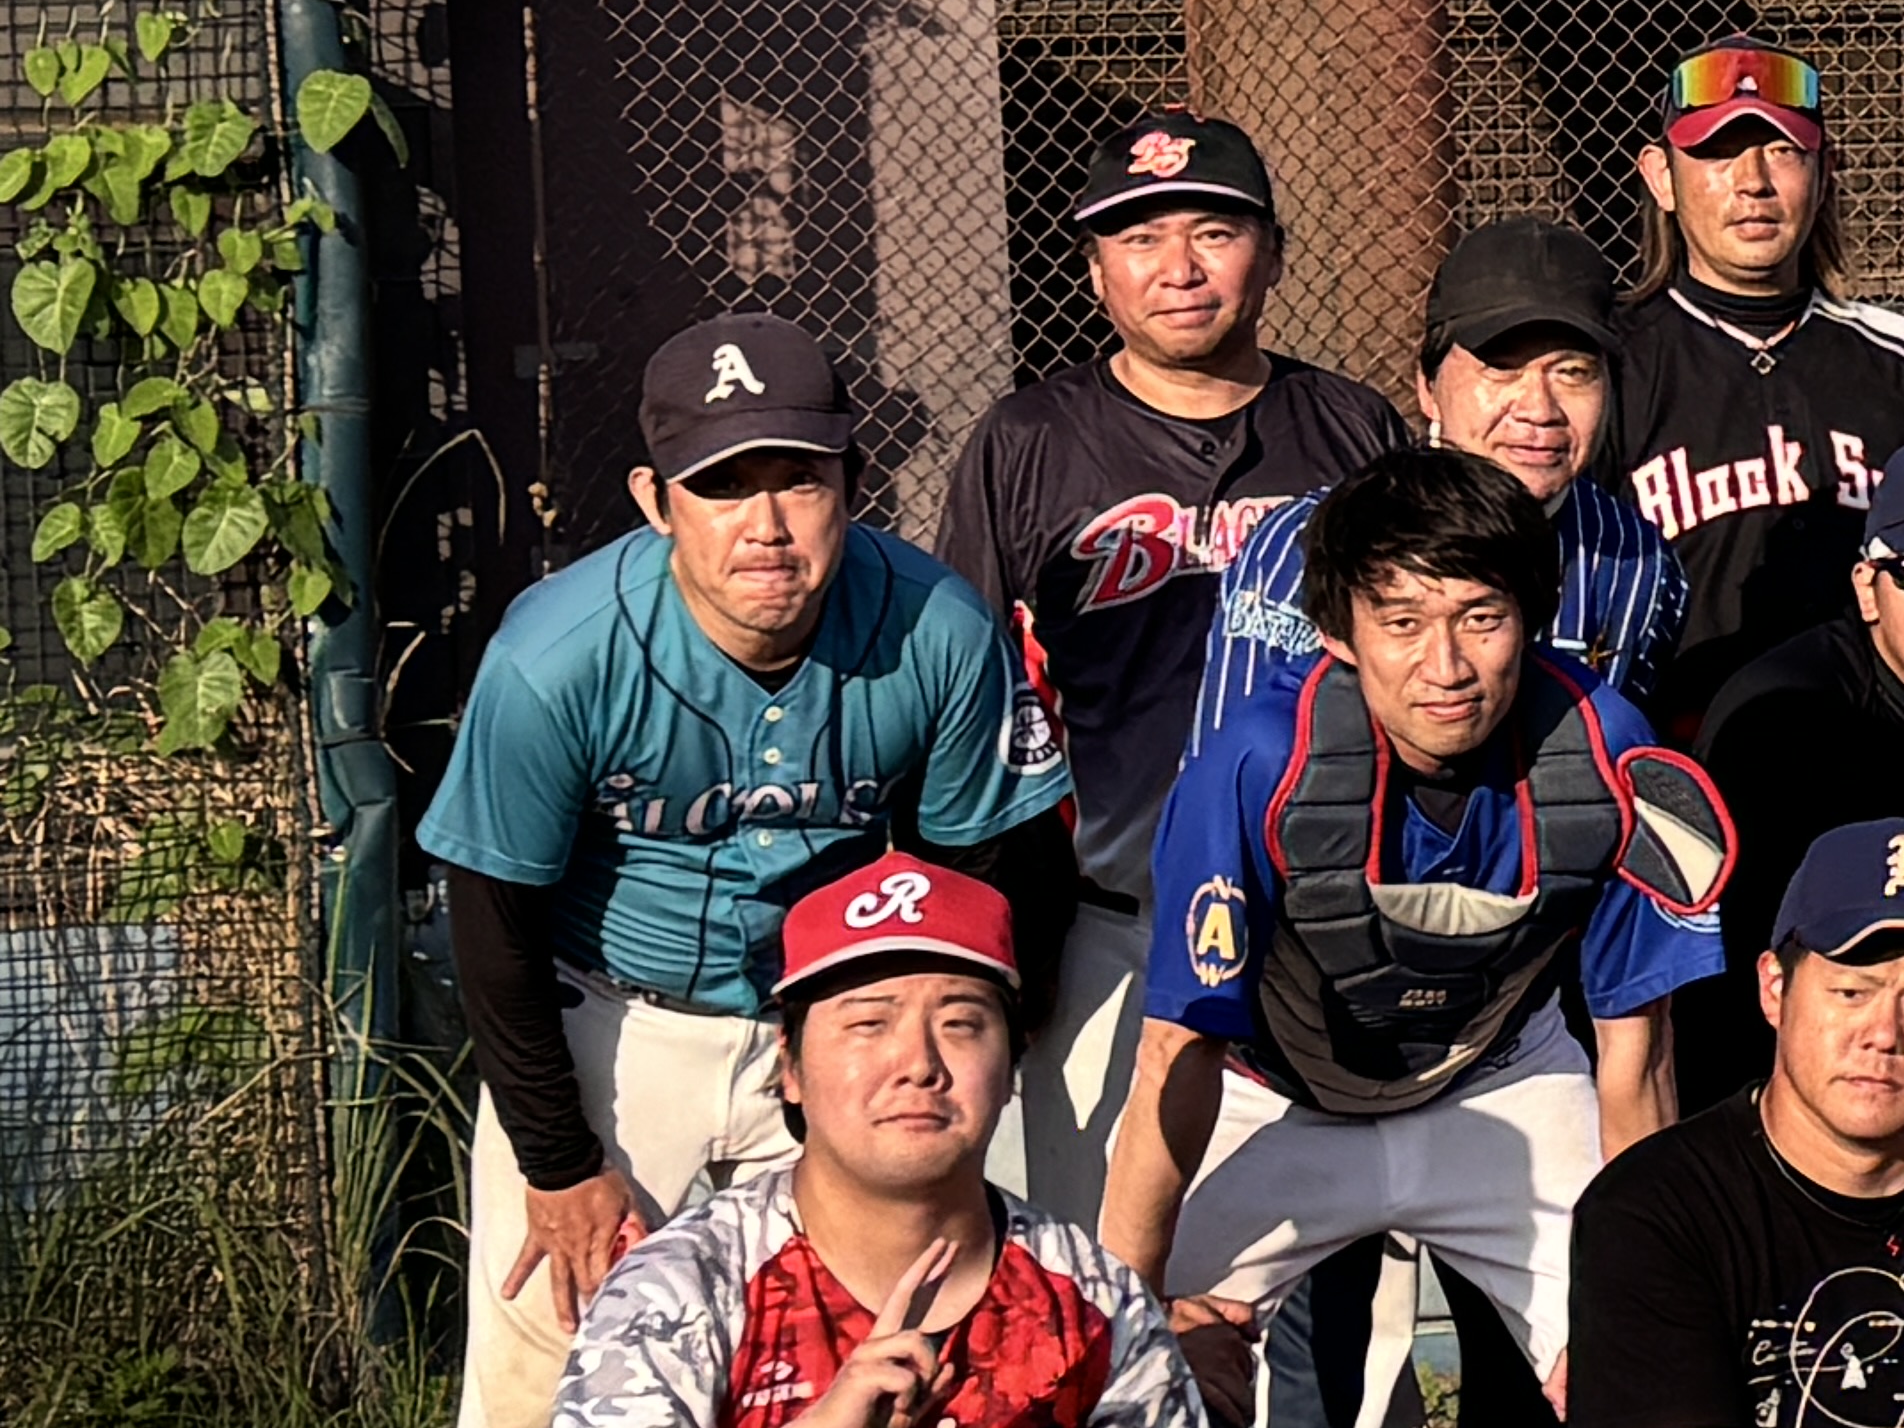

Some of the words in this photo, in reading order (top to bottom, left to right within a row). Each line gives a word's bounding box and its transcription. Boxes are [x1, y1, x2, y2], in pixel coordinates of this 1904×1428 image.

[704, 343, 764, 404] A
[1829, 430, 1885, 510] S
[845, 870, 932, 929] R
[1195, 901, 1237, 961] A
